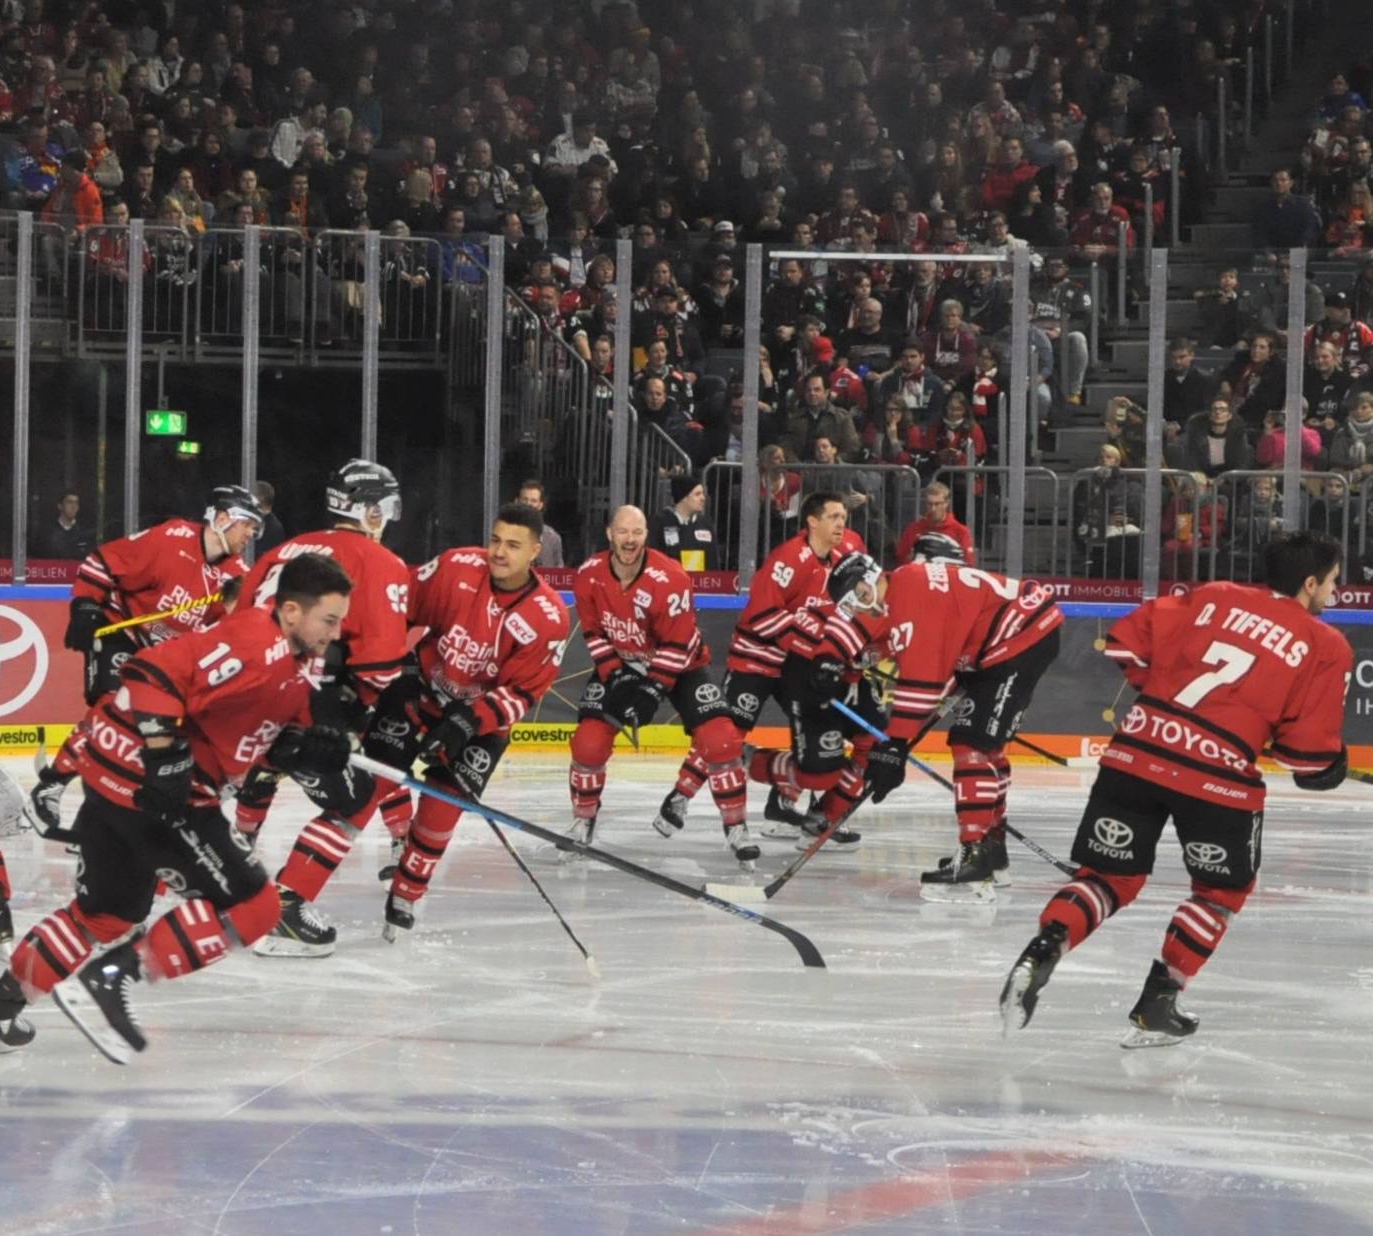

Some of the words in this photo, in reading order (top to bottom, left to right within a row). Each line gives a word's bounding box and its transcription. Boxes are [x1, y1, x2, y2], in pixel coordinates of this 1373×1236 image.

[0, 567, 67, 579] IMOBILIEN
[771, 561, 795, 588] 59
[667, 588, 691, 617] 24
[1042, 583, 1072, 597] OTT
[1073, 585, 1143, 598] IMMOBILIE
[1341, 591, 1372, 604] OTT
[1220, 607, 1309, 668] TIFFELS
[198, 641, 244, 687] 19
[1173, 640, 1257, 709] 7
[1087, 837, 1134, 861] TOYOTA
